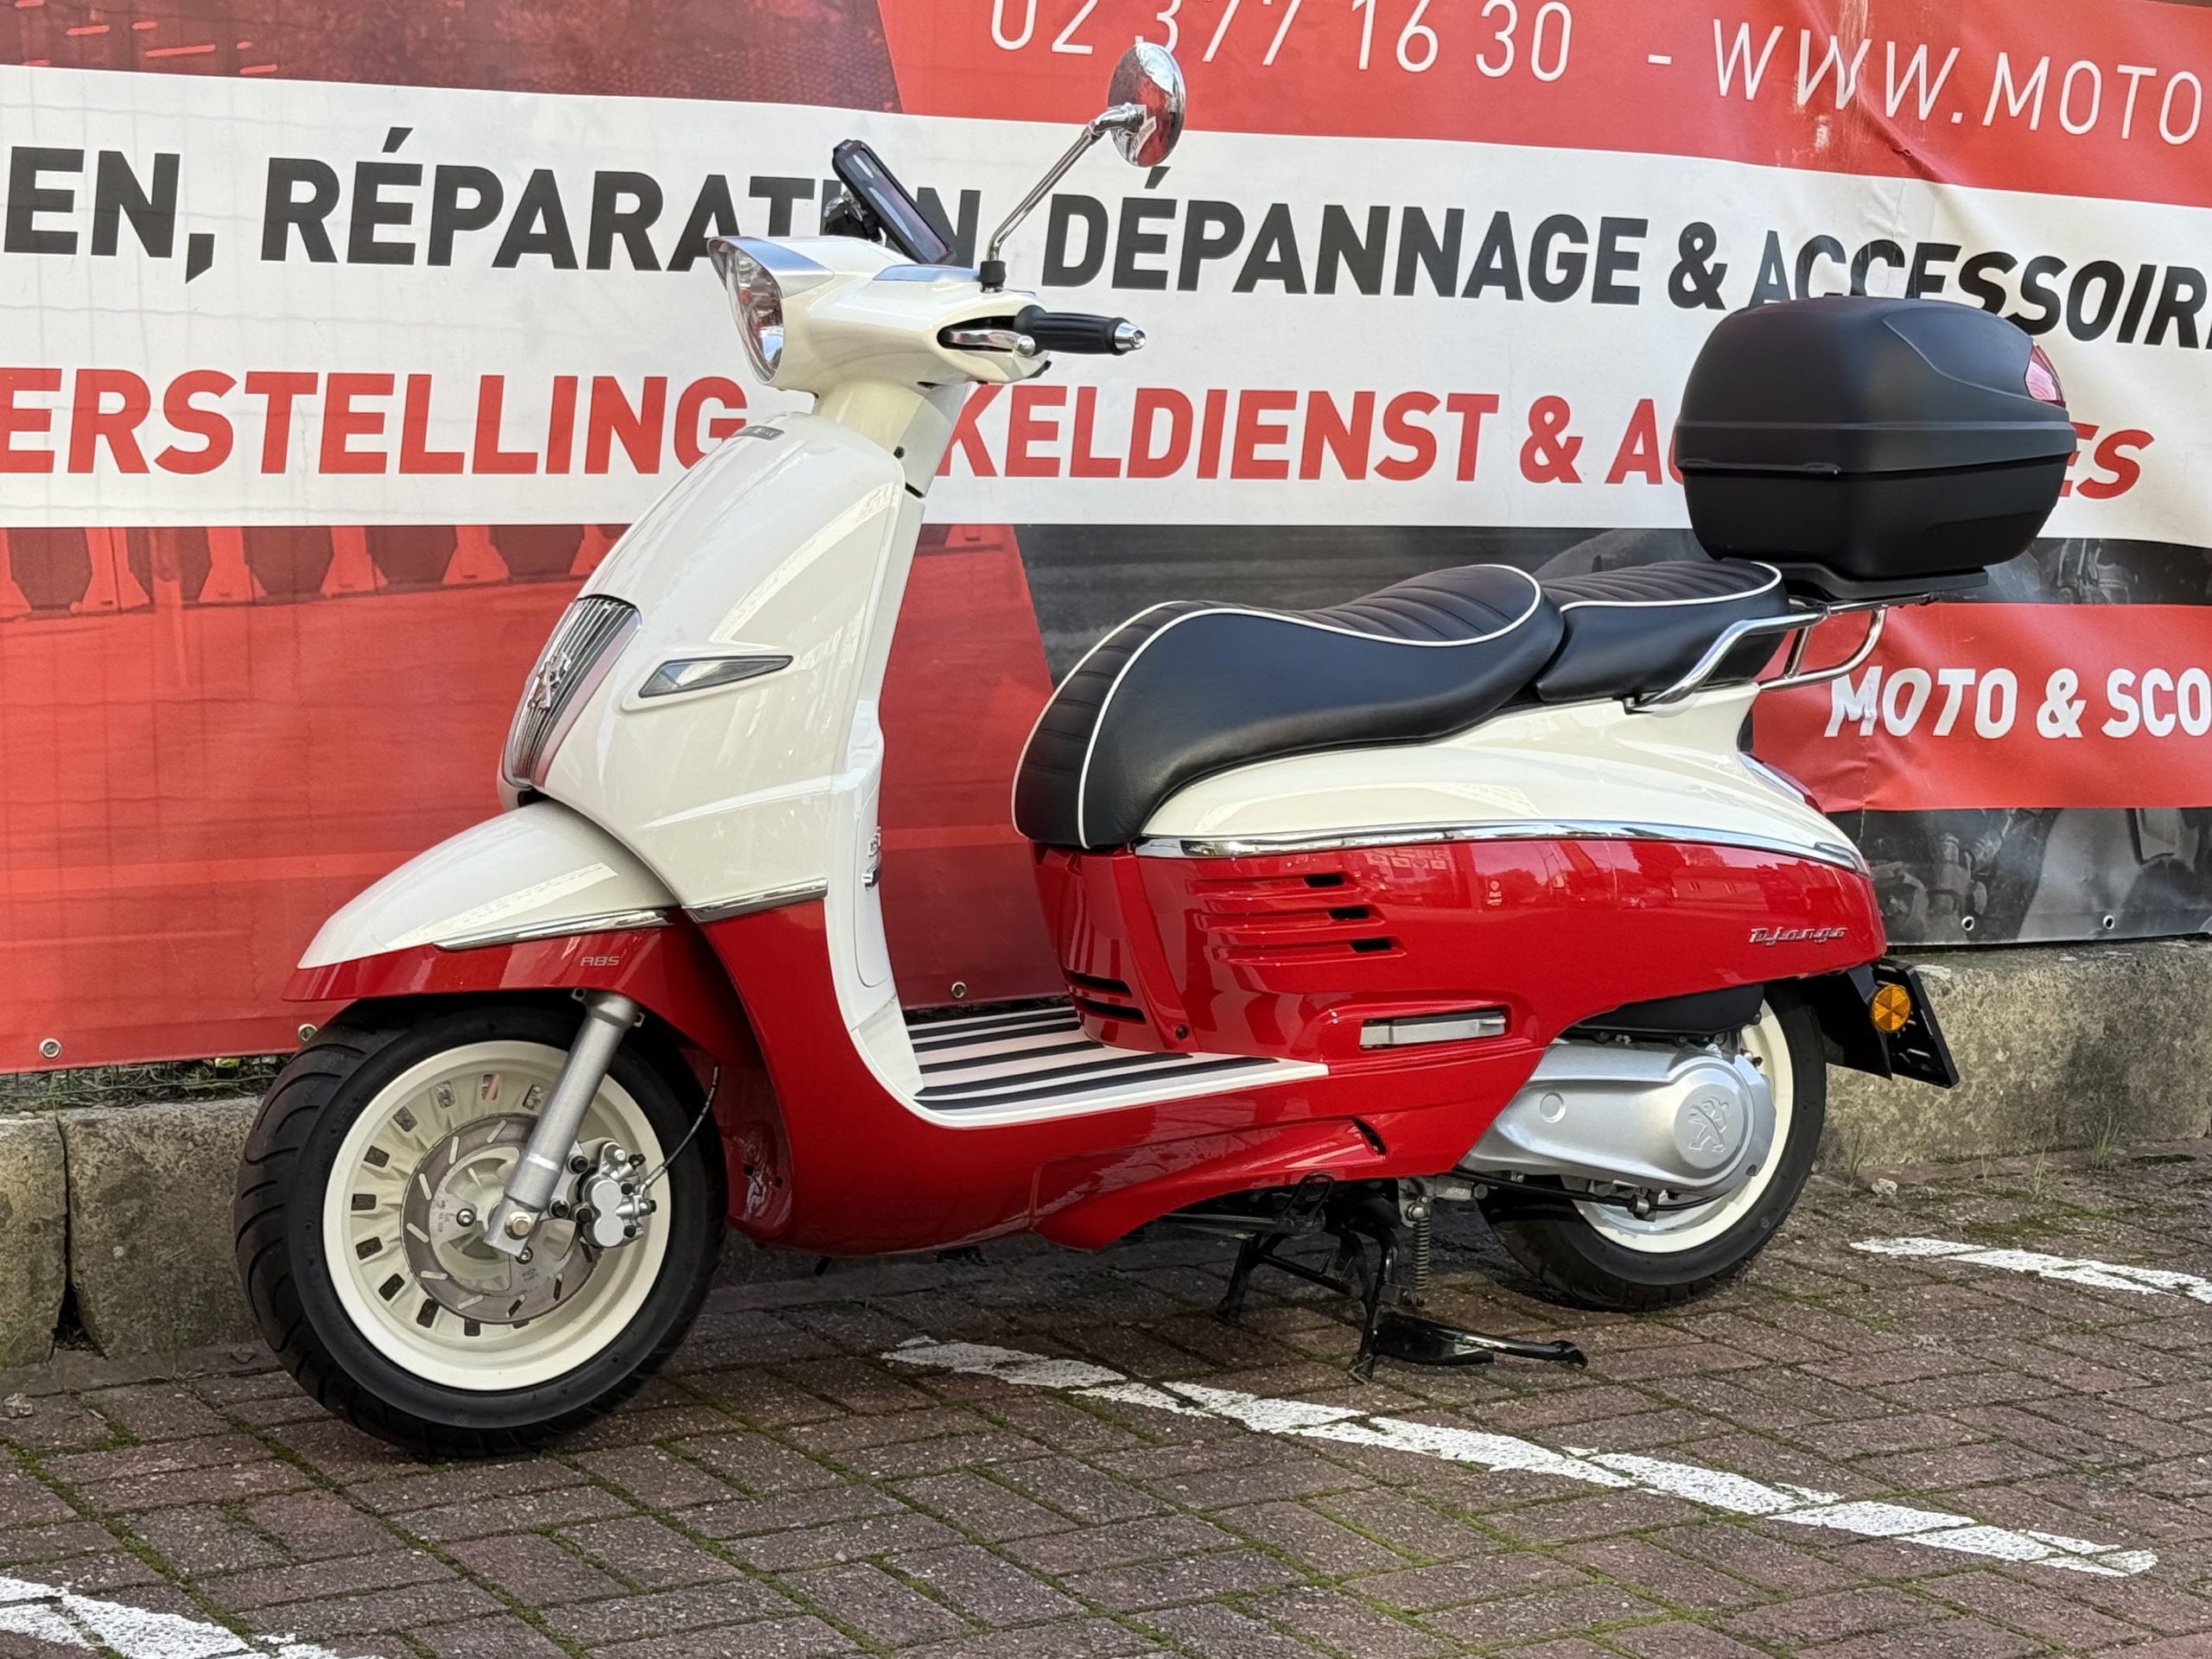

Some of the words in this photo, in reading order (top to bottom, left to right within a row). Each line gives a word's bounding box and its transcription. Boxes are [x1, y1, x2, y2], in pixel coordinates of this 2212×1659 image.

[991, 0, 1097, 54] 02
[1352, 0, 1438, 72] 16
[1476, 1, 1572, 81] 30
[1713, 19, 2202, 144] WWW.MOTO
[3, 146, 214, 283] EN,
[261, 126, 982, 272] RÉPARATN
[1041, 167, 1649, 305] DÉPANNAGE
[1668, 221, 1728, 310] &
[1747, 230, 2212, 351] ACCESSOIR
[0, 367, 747, 474] ERSTELLING
[1519, 396, 1582, 484] &
[1824, 665, 2018, 739] MOTO
[2036, 668, 2087, 739] &
[2101, 667, 2212, 738] SCO
[581, 956, 620, 967] ABS
